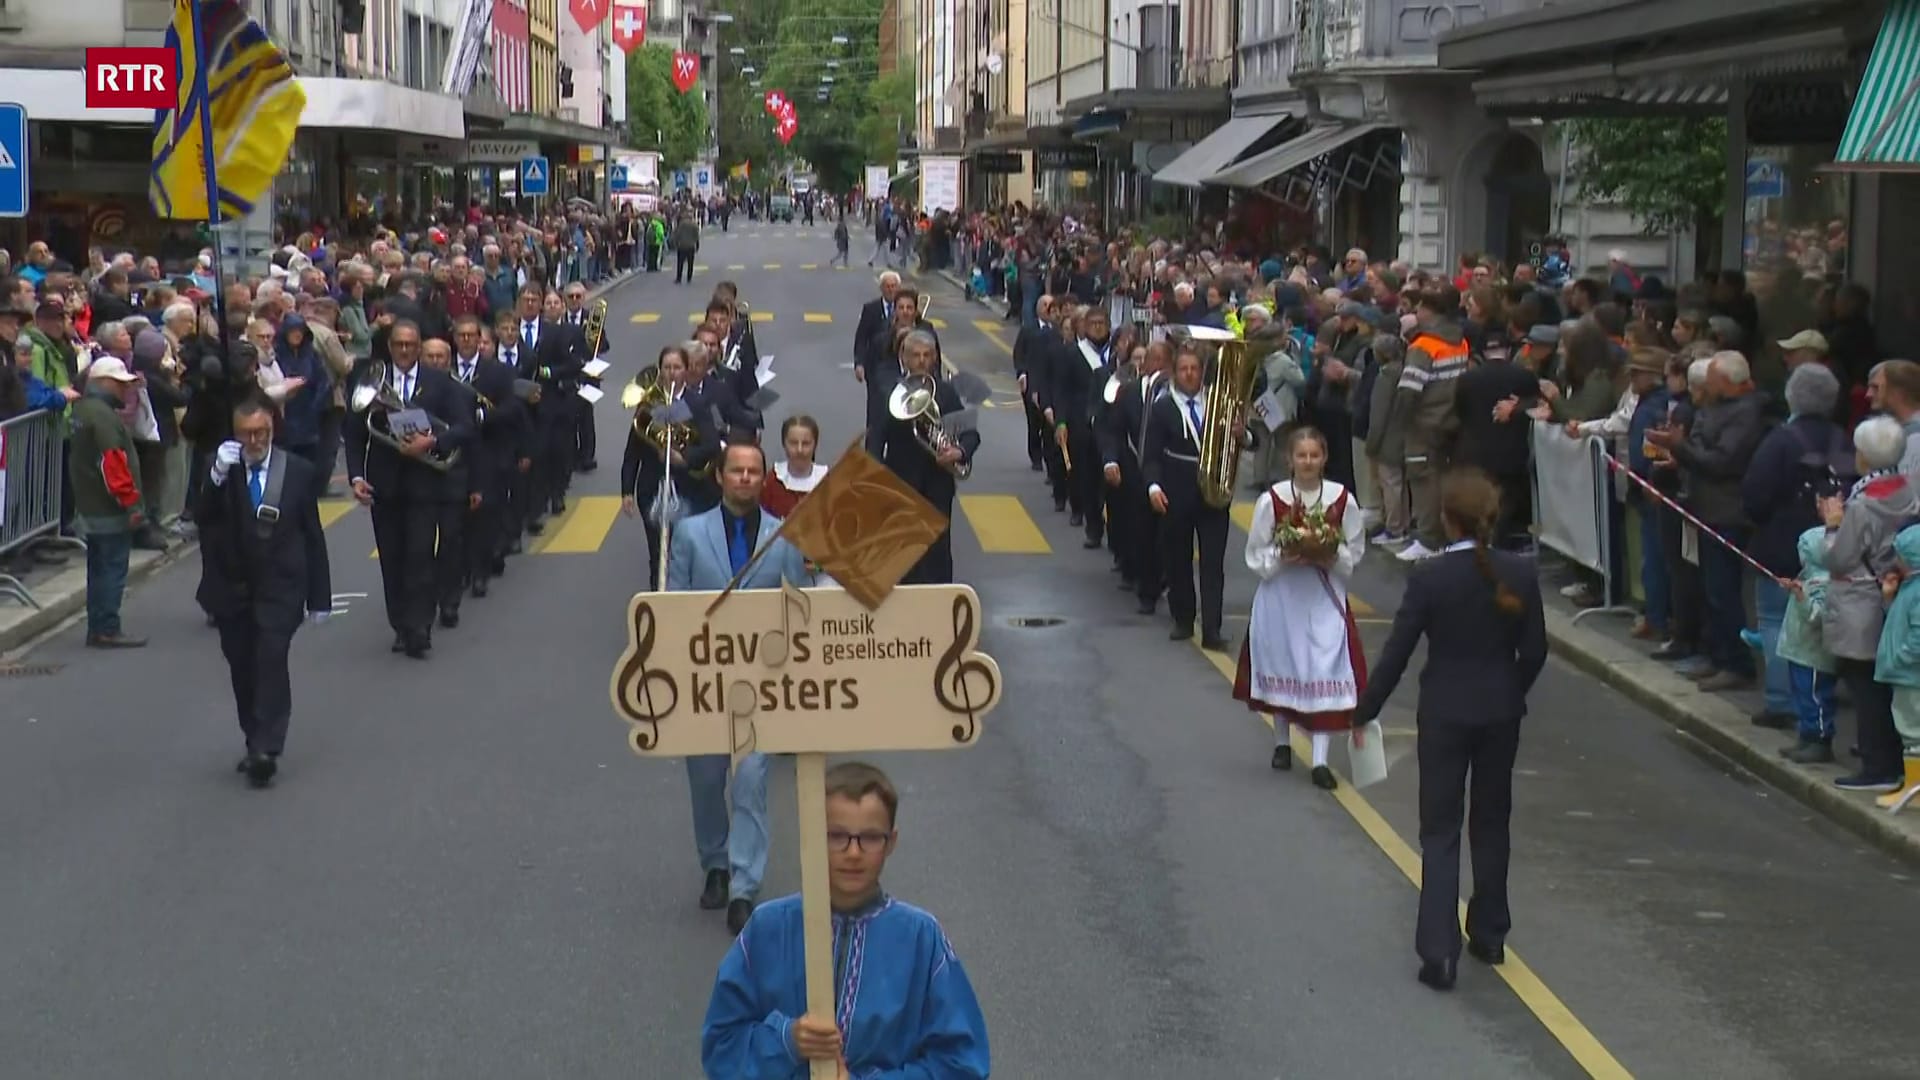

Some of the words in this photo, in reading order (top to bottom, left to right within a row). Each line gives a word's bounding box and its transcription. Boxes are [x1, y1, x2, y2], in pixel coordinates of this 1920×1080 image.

[821, 613, 875, 636] musik
[689, 621, 811, 668] davos
[822, 637, 932, 665] gesellschaft
[691, 672, 859, 717] klosters
